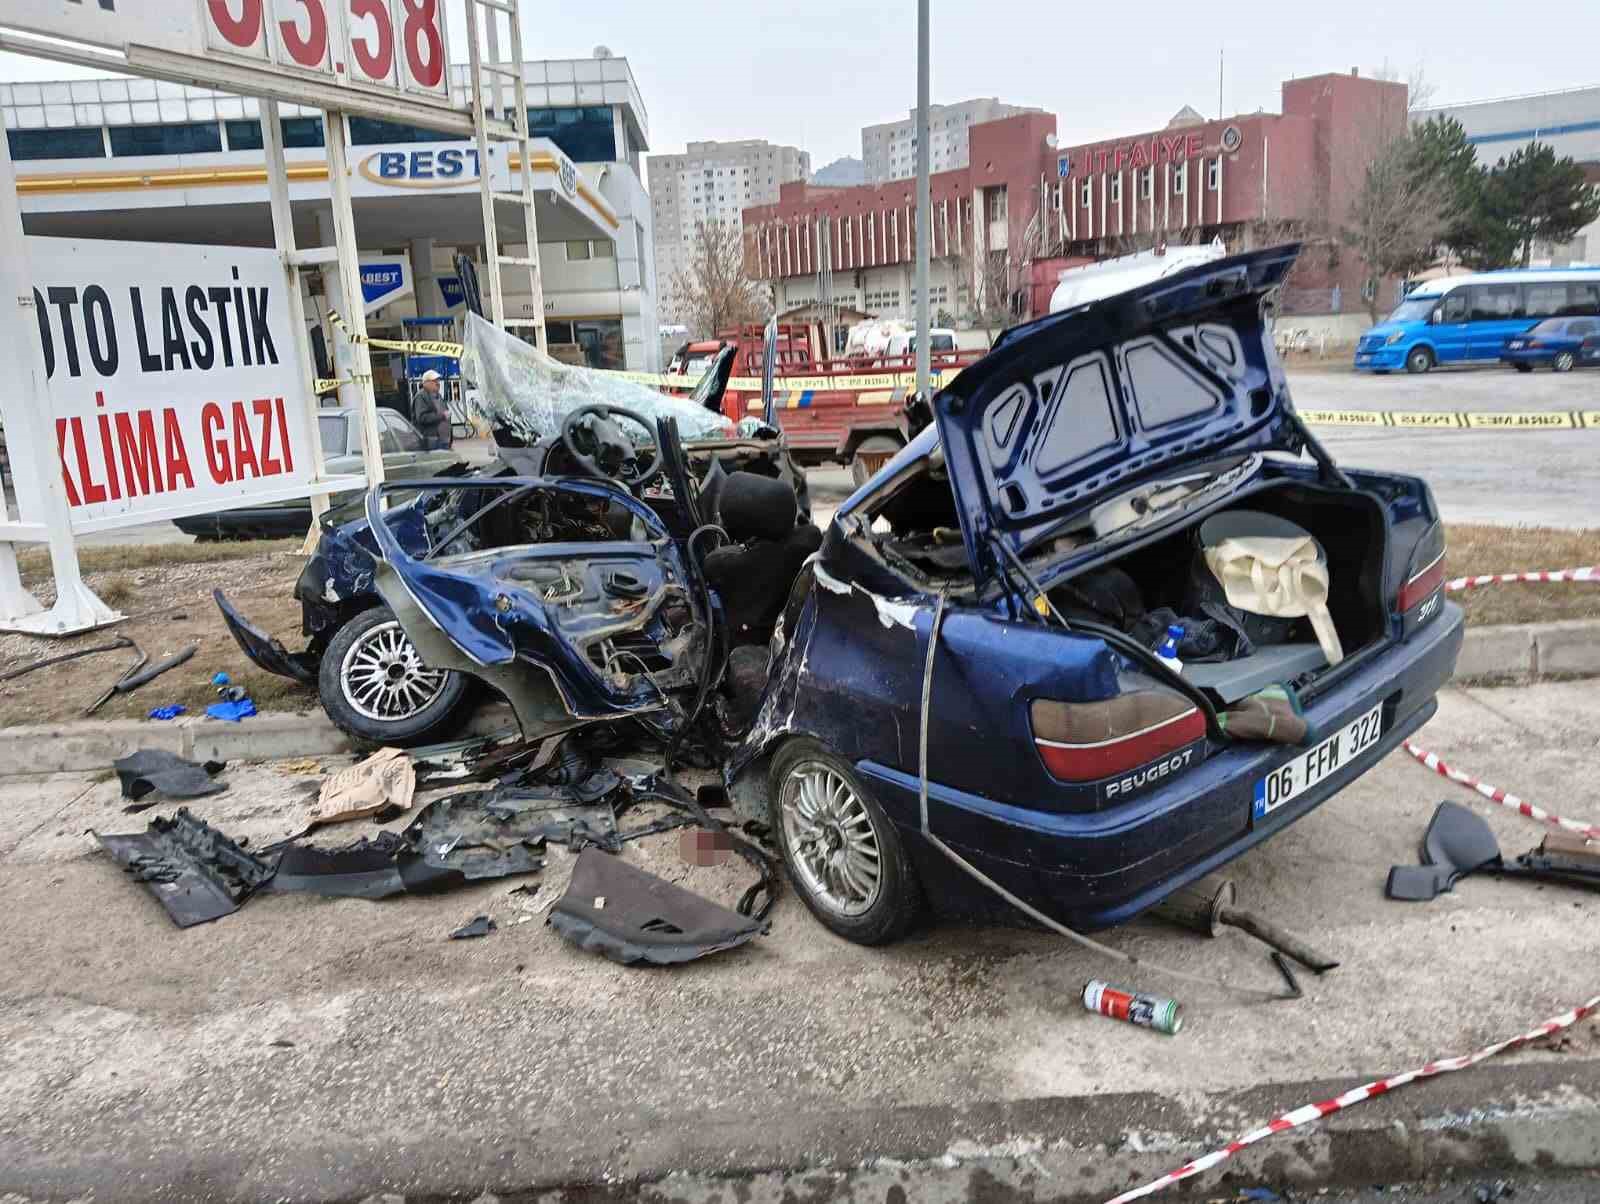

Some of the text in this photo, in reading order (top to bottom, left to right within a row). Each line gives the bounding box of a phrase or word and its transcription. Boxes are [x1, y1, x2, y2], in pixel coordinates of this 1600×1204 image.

[379, 149, 490, 179] BEST
[129, 265, 279, 372] LASTİK
[201, 398, 294, 485] GAZI
[1105, 749, 1193, 799] PEUGEOT
[1267, 710, 1380, 805] 06 FFM 322
